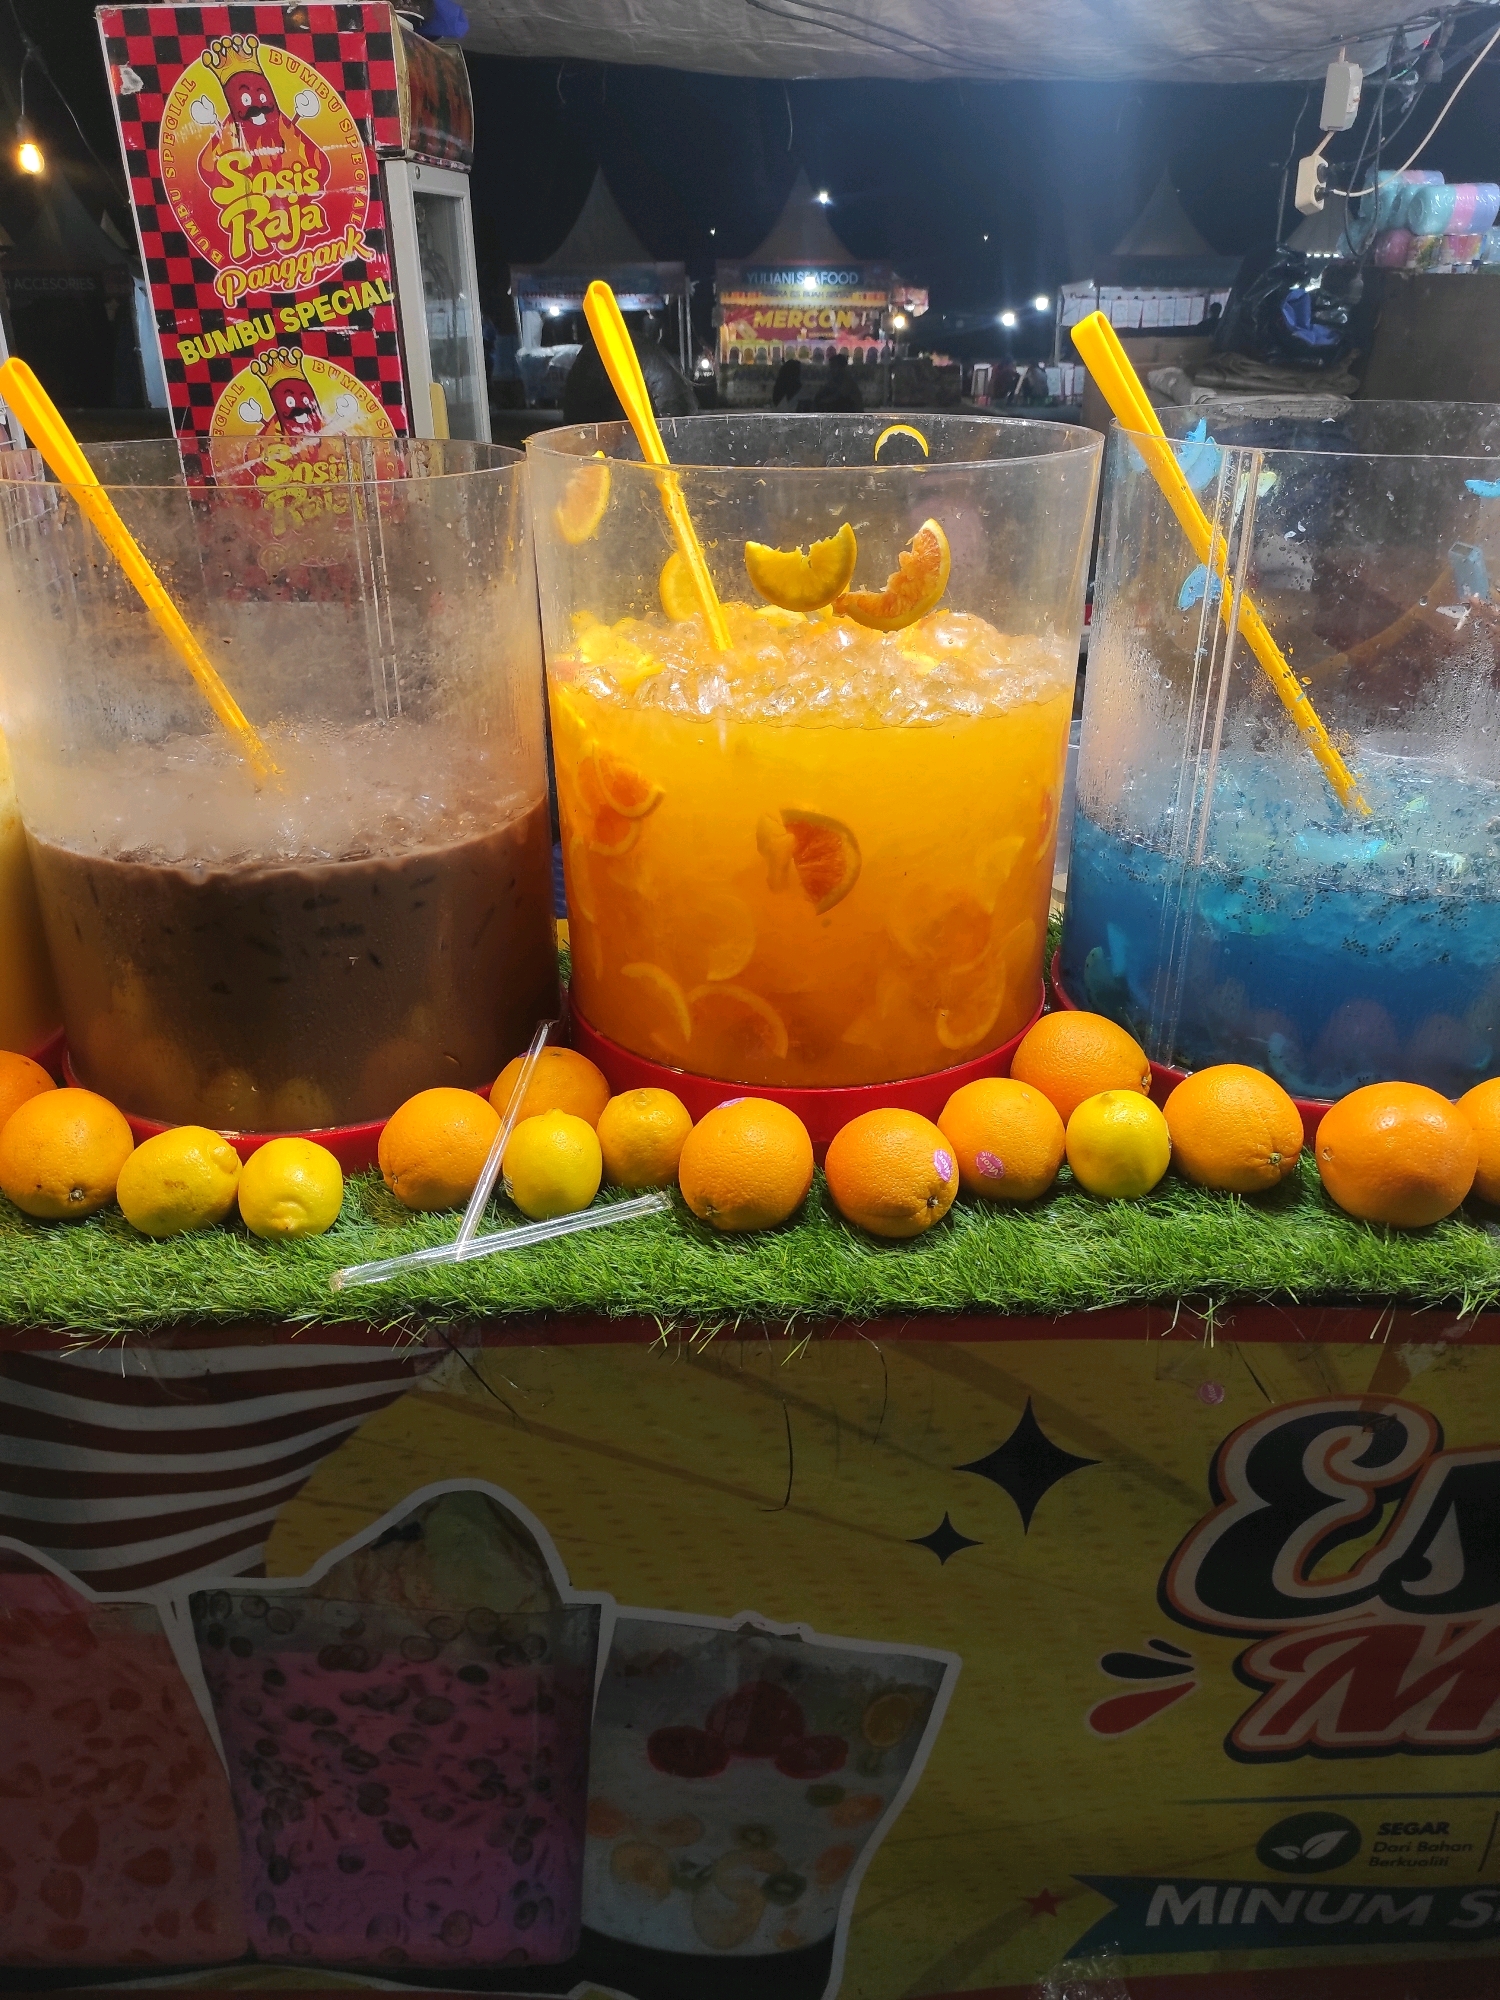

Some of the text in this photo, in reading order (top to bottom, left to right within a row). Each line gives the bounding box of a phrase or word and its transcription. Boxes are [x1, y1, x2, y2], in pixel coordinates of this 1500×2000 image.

[269, 48, 368, 224] BUMBU SPECIAL
[163, 78, 224, 265] BUMBU SPECIAL
[211, 149, 320, 205] Sosis
[221, 192, 326, 260] Raja
[215, 226, 376, 309] Panggank
[177, 276, 396, 366] BUMBU SPECIAL
[753, 310, 852, 329] MERCON
[312, 359, 379, 415] BUMBU
[1372, 1840, 1474, 1853] Dari Bahan
[1376, 1821, 1451, 1836] SEGAR
[1368, 1855, 1450, 1868] Berkualiti
[1144, 1883, 1500, 1930] MINUM S
